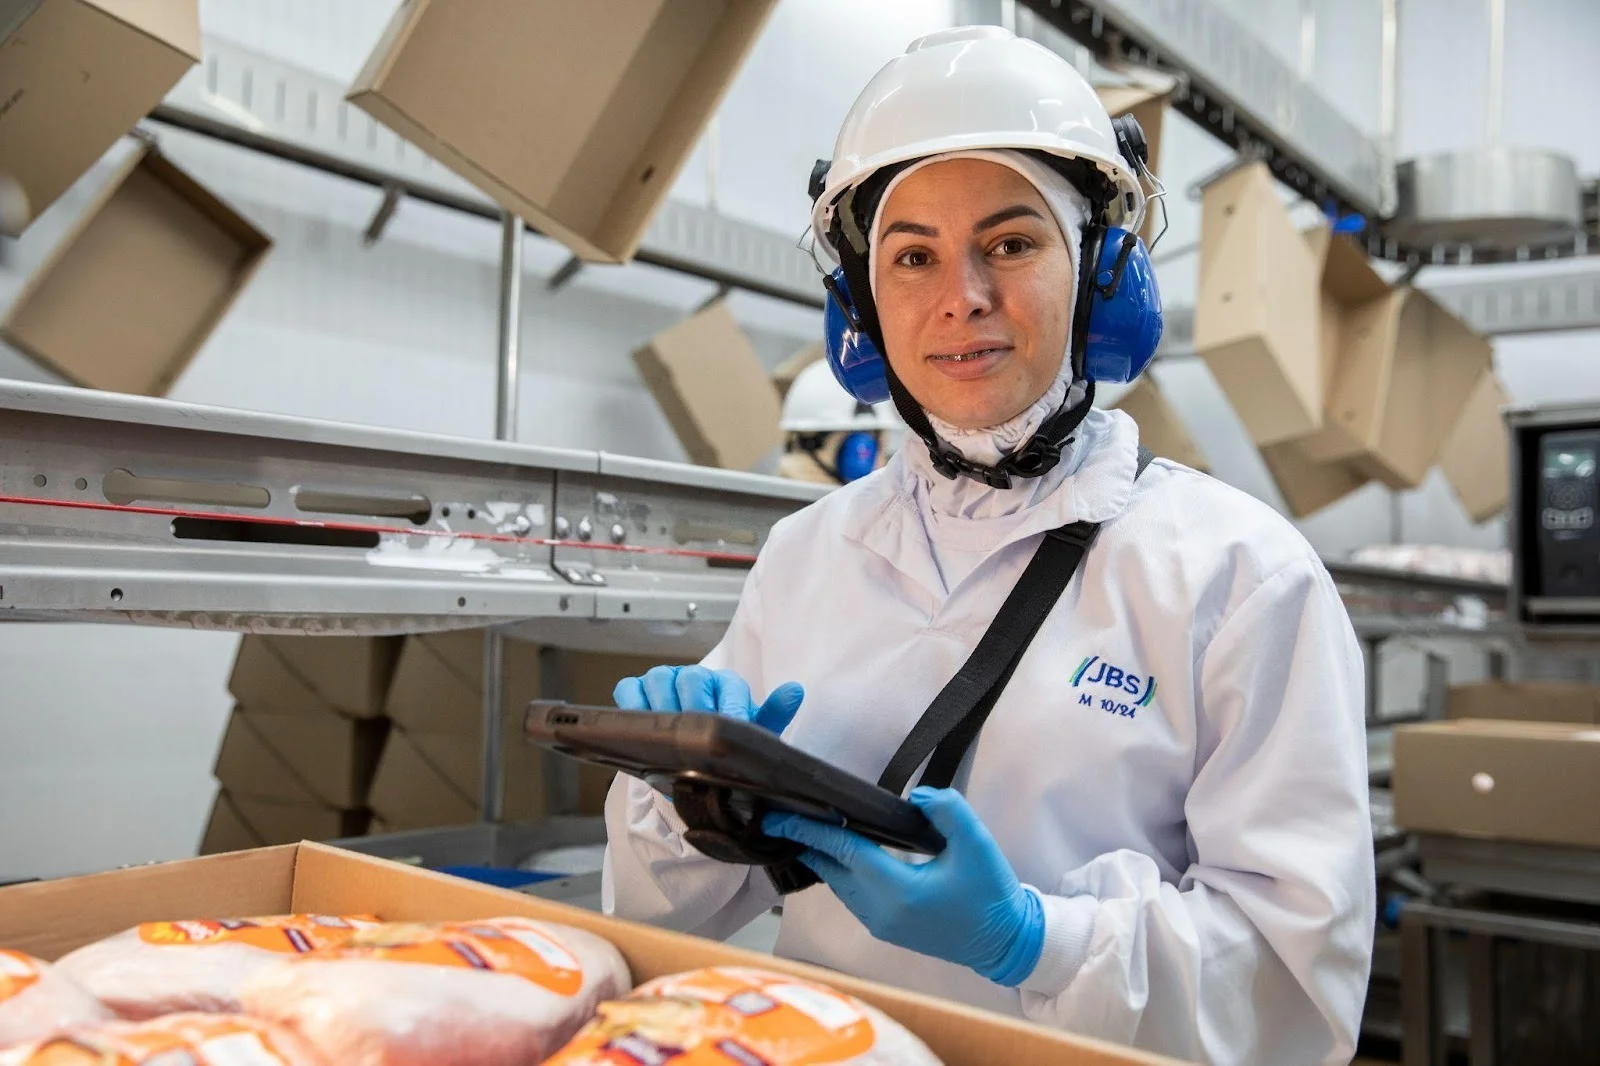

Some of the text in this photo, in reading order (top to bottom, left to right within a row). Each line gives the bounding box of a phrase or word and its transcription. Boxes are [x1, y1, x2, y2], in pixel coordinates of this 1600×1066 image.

[1087, 663, 1140, 695] JBS
[1078, 693, 1136, 719] M 10/24
